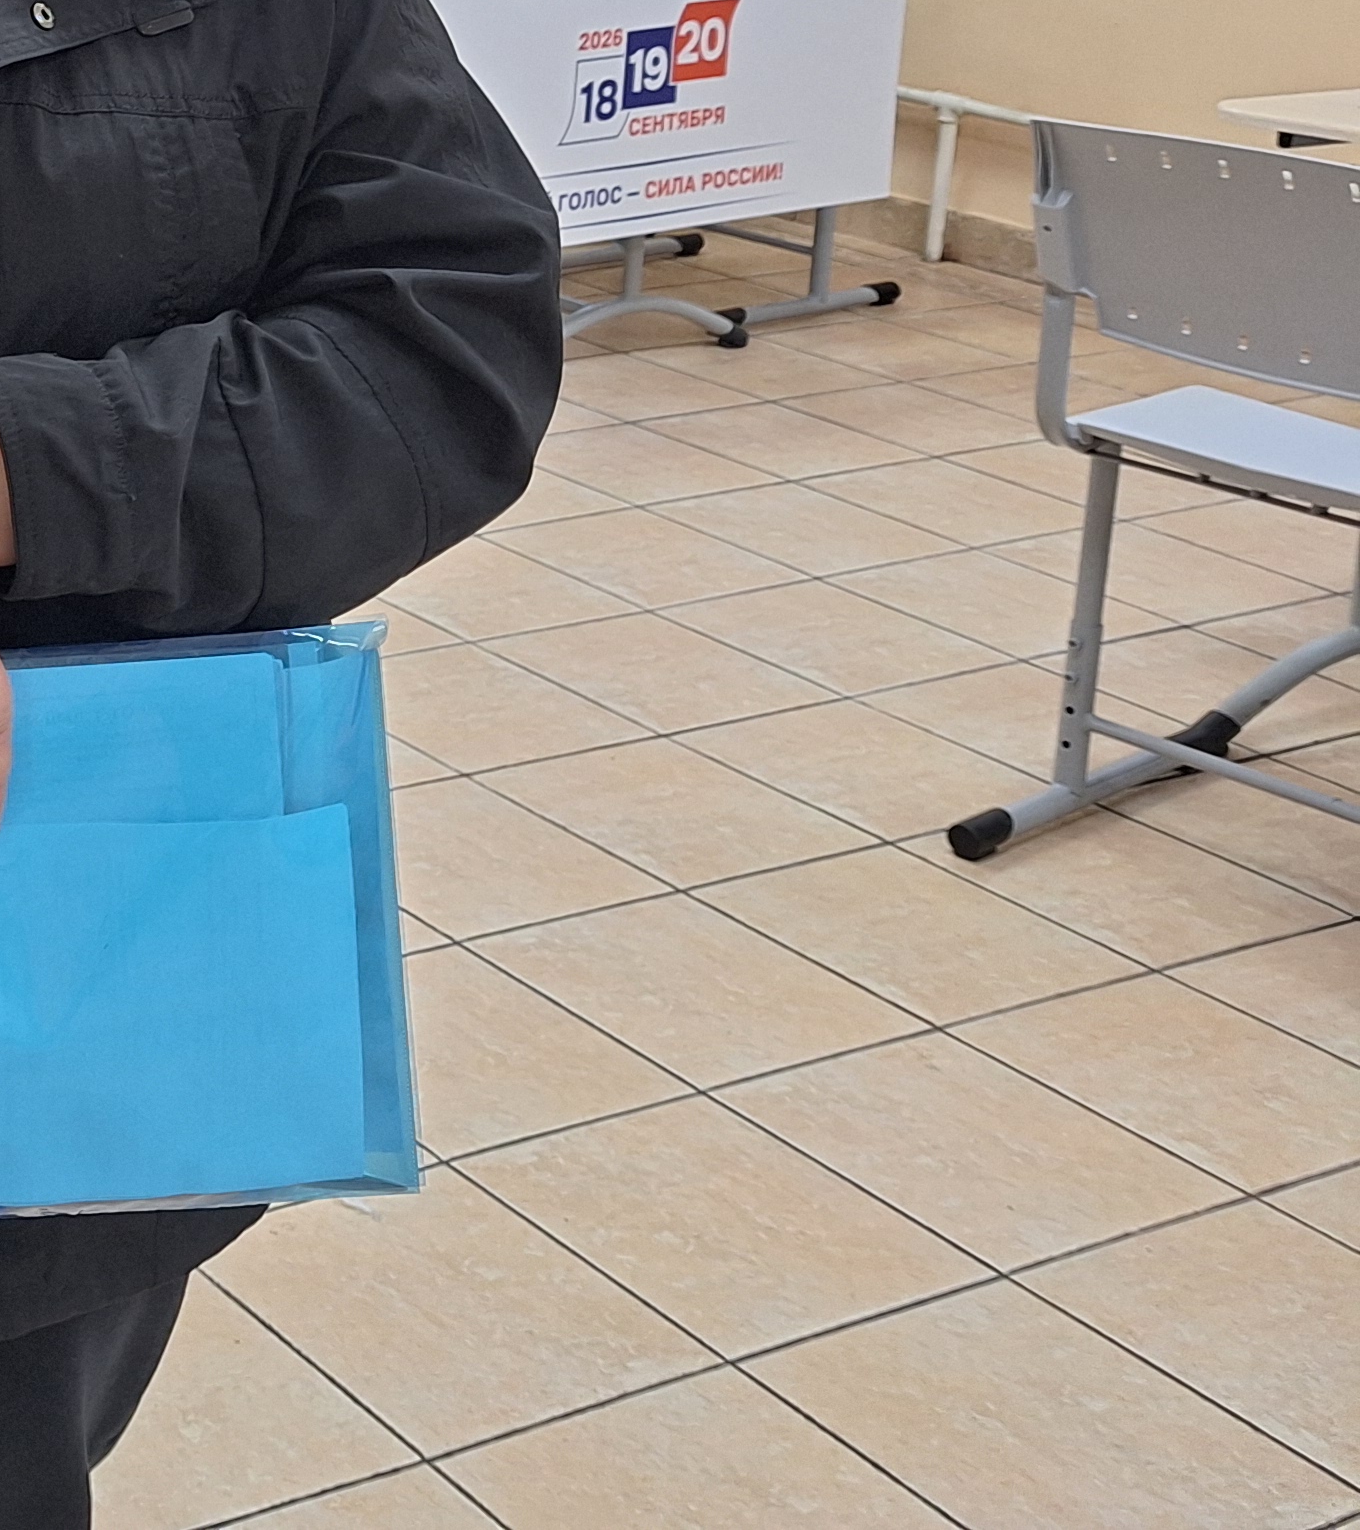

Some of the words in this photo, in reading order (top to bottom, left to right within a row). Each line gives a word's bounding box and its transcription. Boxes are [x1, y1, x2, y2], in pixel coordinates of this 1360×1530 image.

[578, 28, 623, 51] 2026
[580, 79, 618, 124] 18
[629, 46, 668, 93] 19
[676, 16, 726, 65] 20
[629, 106, 725, 136] СЕНТЯБРЯ
[558, 185, 622, 212] ГОЛОС
[645, 176, 696, 199] СИЛА
[701, 162, 784, 191] РОССИИ!
